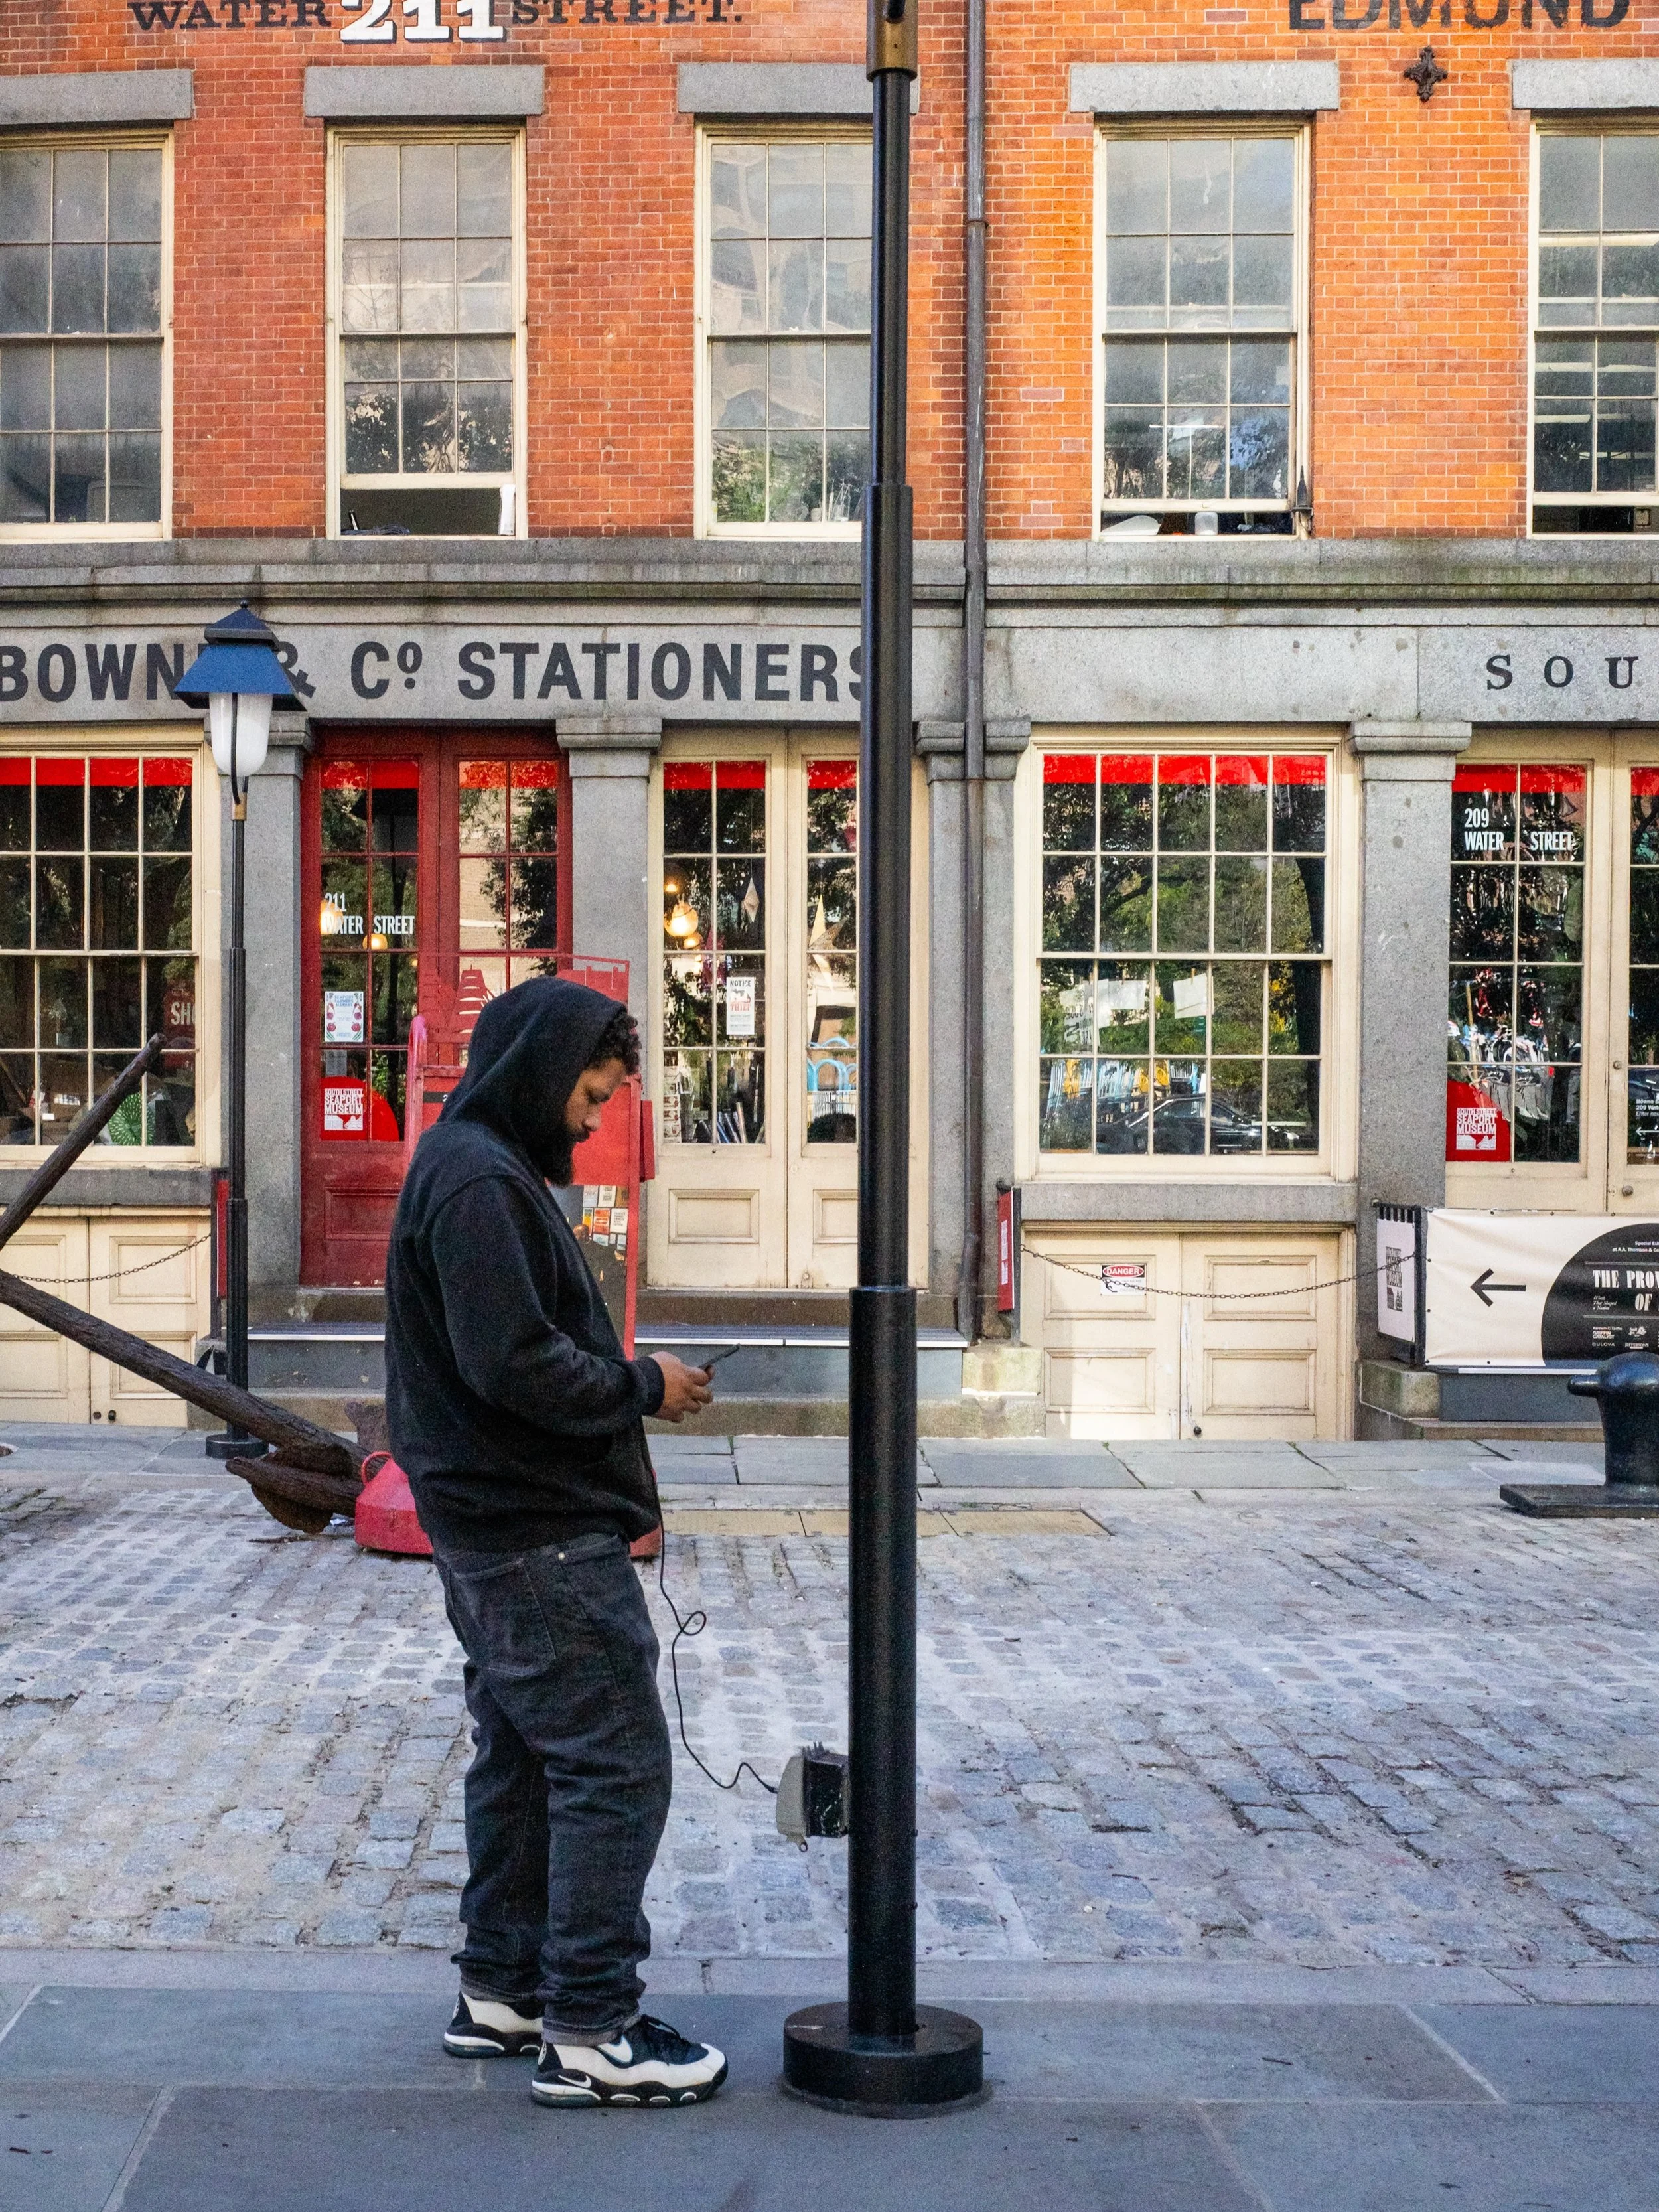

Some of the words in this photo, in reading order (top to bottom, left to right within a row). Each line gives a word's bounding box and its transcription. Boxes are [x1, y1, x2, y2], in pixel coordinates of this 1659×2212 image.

[132, 1, 332, 30] WATER
[340, 0, 507, 44] 211
[1289, 0, 1630, 29] EDMOND
[0, 644, 206, 703] BOWN
[1464, 808, 1489, 828] 209
[1465, 831, 1504, 850] WATER
[1530, 831, 1573, 851] STREET
[325, 892, 346, 912] 211
[374, 915, 415, 934] STREET
[325, 1096, 363, 1104] SEAPORT
[325, 1104, 362, 1114] MUSEUM
[1457, 1115, 1496, 1124] SEAPORT
[1457, 1124, 1496, 1134] MUSEUM
[1593, 1270, 1619, 1288] THE
[1635, 1293, 1652, 1311] OF
